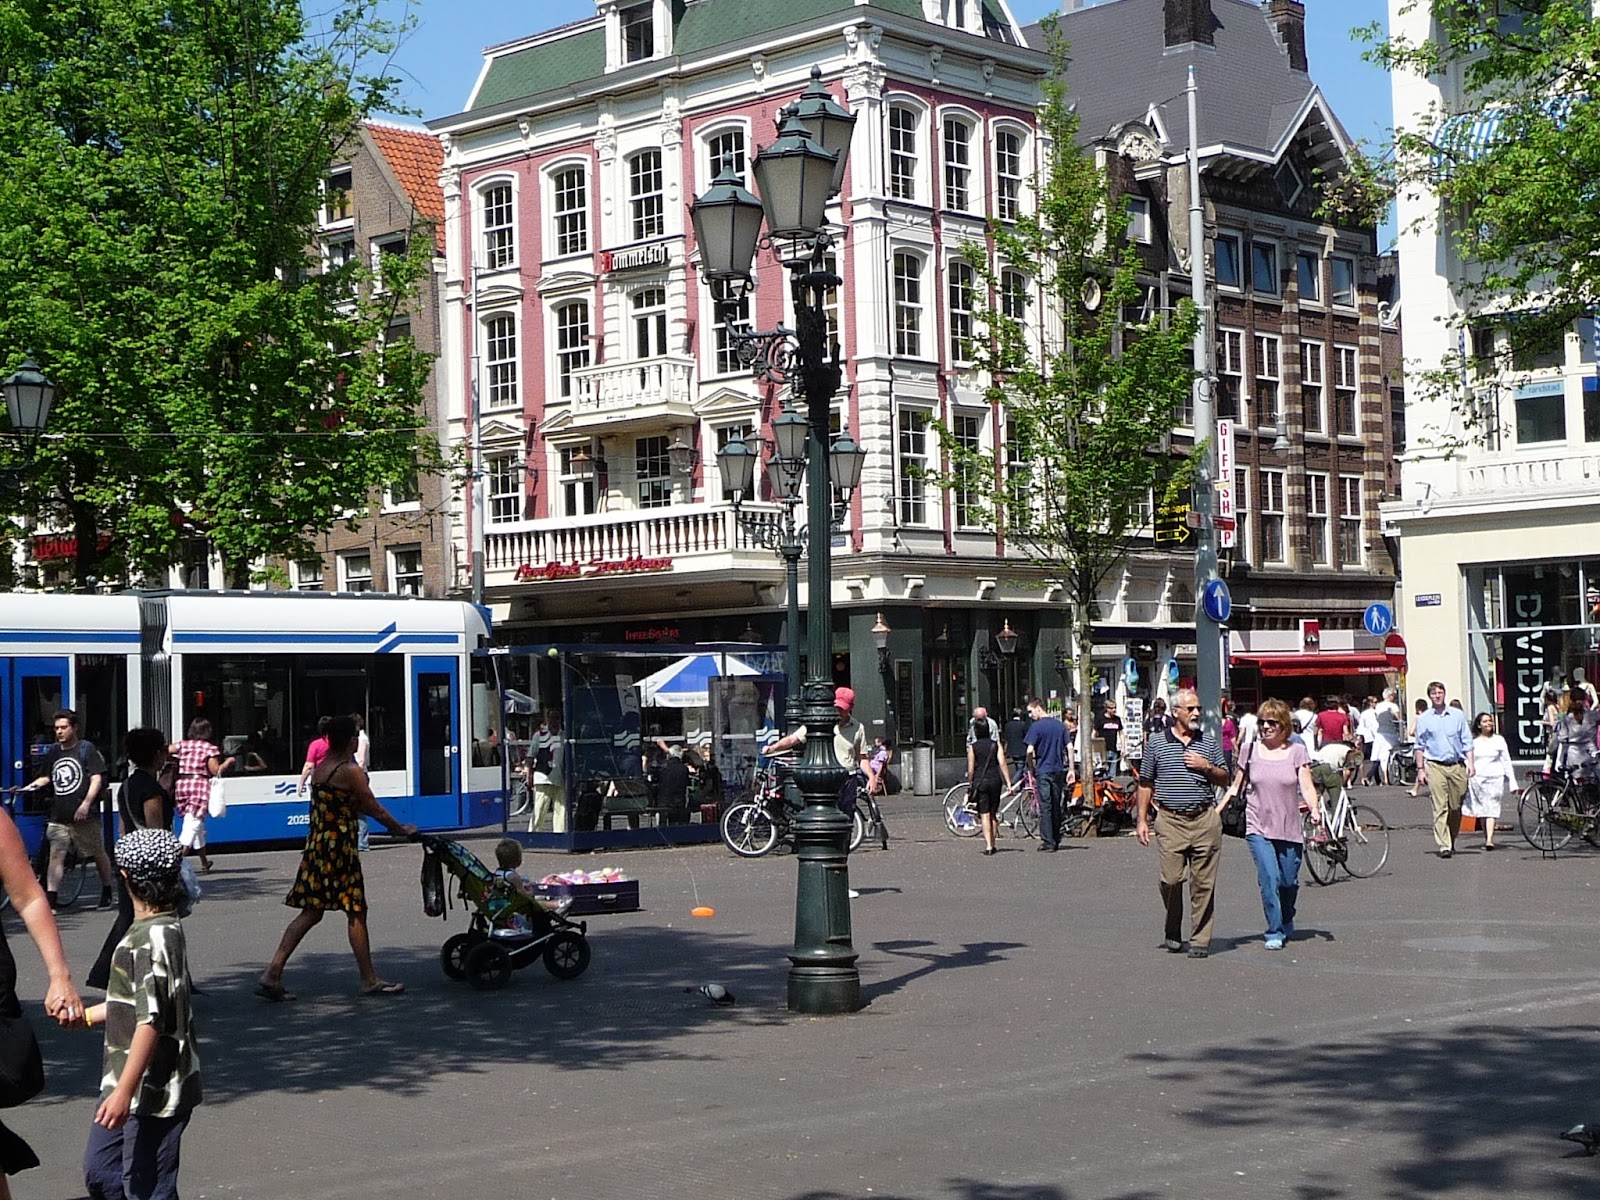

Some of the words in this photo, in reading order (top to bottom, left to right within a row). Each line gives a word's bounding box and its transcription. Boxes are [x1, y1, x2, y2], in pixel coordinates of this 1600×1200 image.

[1528, 383, 1560, 393] randstad
[1220, 423, 1229, 479] GIFT
[1222, 489, 1231, 545] SHP
[583, 555, 672, 576] Steakhouse
[1515, 594, 1544, 744] DIVIDED
[287, 815, 310, 825] 2025
